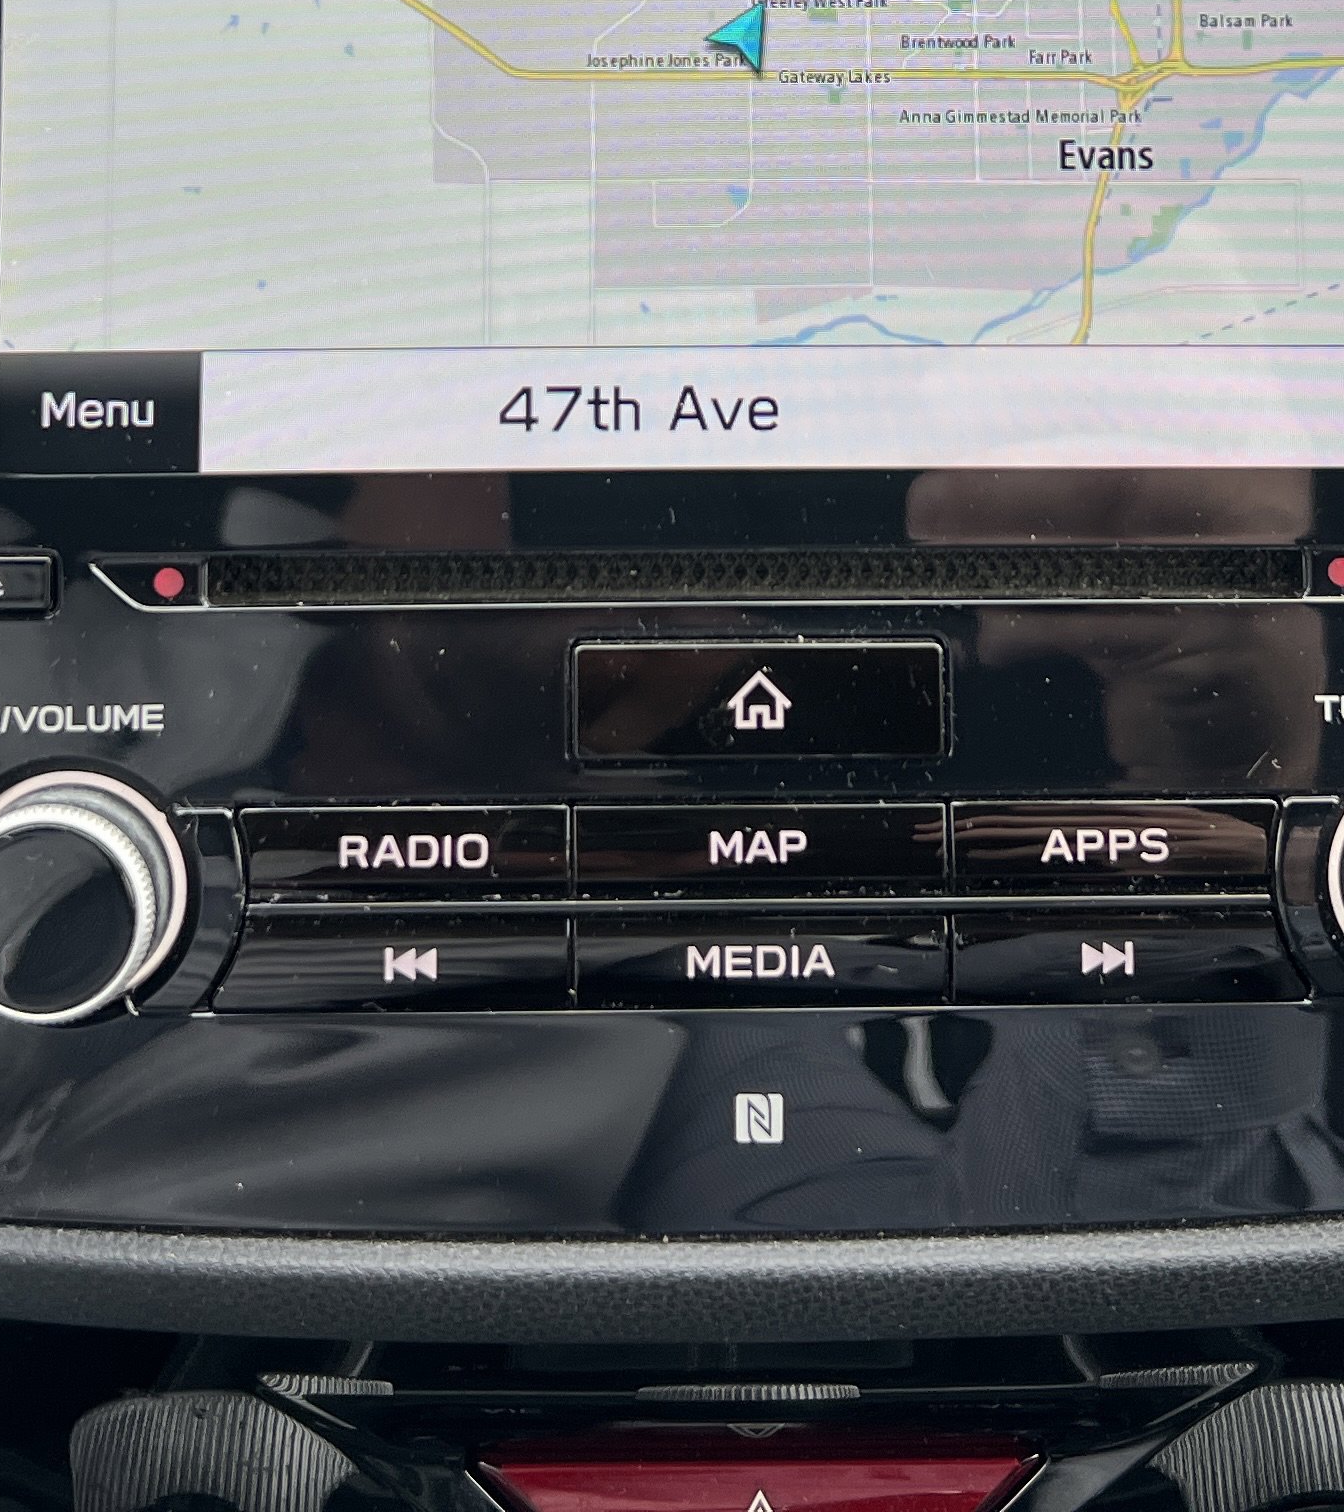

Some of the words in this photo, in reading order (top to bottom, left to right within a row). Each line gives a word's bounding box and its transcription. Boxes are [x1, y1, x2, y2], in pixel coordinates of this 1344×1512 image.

[1200, 13, 1256, 28] Balsam
[1259, 13, 1293, 28] Park
[900, 35, 978, 50] Brentwood
[982, 35, 1015, 50] Park
[1029, 49, 1054, 65] Farr
[1057, 49, 1092, 65] Park
[587, 53, 663, 69] Josephine
[667, 53, 711, 69] Jones
[778, 70, 843, 86] Gateway
[848, 70, 891, 86] Lakes
[900, 109, 941, 124] Anna
[945, 109, 1030, 124] Gimmestad
[1036, 109, 1105, 124] Memorial
[1108, 109, 1141, 124] Park
[1058, 140, 1154, 172] Evans
[41, 392, 155, 428] Menu
[499, 386, 642, 432] 47th
[670, 386, 780, 432] Ave
[338, 834, 491, 870] RADIO
[709, 829, 808, 865] MAP
[1041, 828, 1170, 864] APPS
[686, 944, 836, 979] MEDIA
